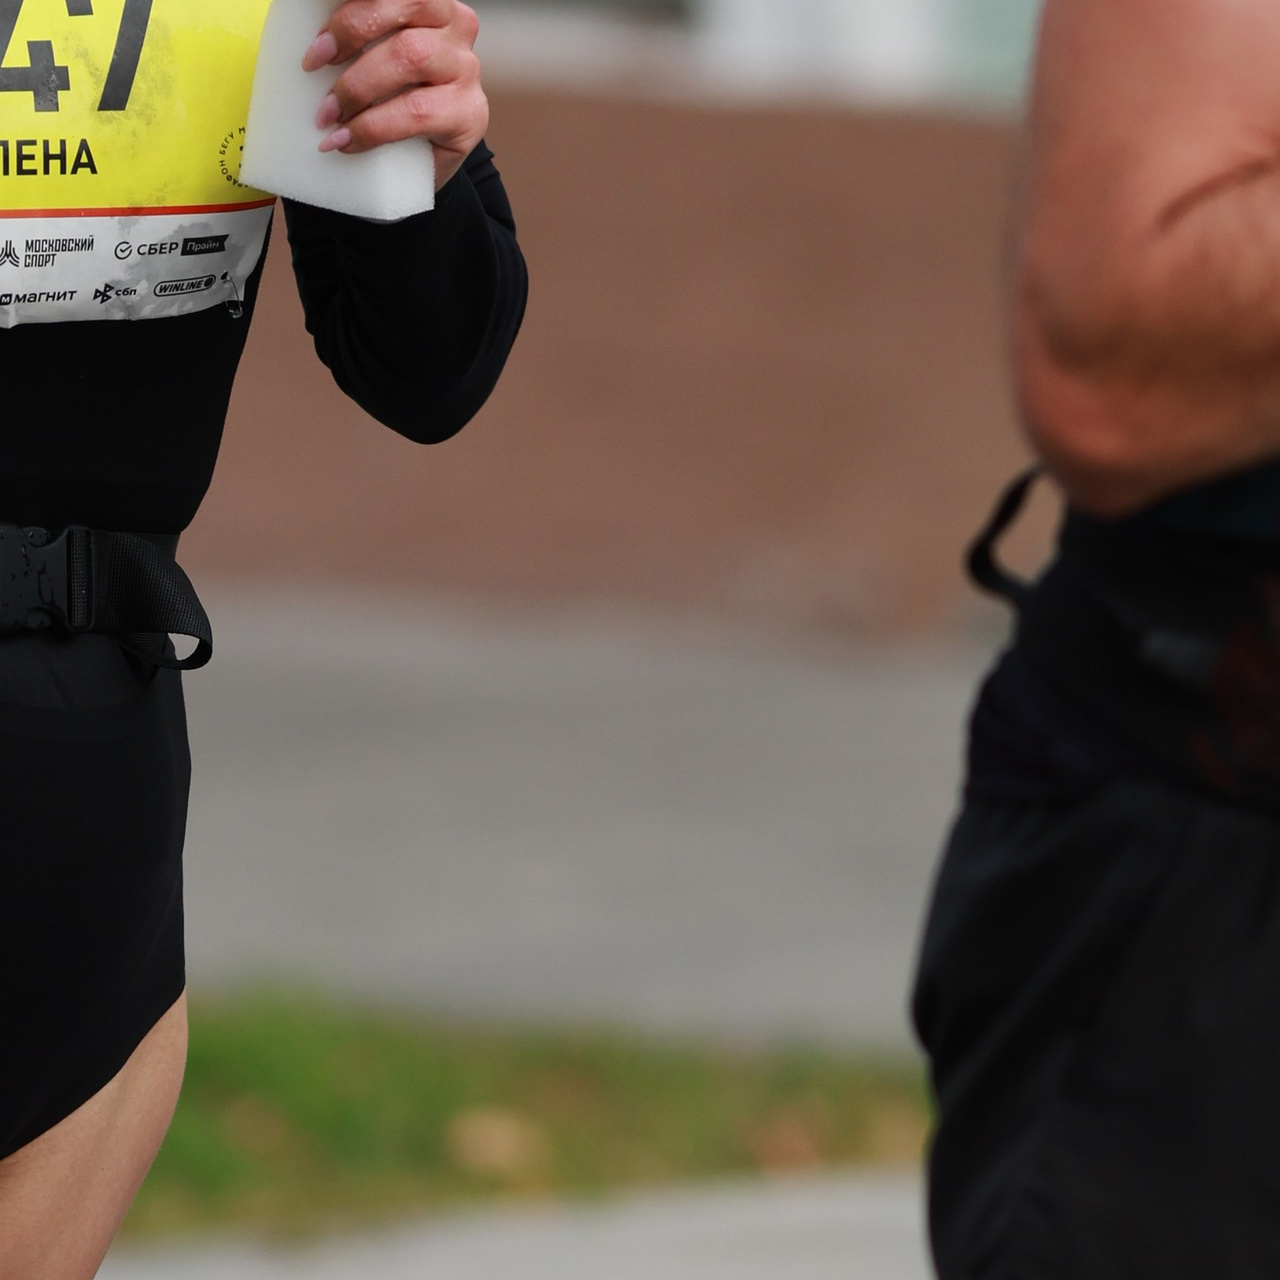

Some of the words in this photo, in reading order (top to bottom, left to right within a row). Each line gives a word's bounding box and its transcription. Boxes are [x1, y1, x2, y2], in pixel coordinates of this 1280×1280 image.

[25, 235, 94, 253] МОСКОВСКИЙ
[137, 242, 179, 256] СБЕР
[186, 240, 220, 252] Прайм
[24, 253, 57, 267] СПОРТ
[158, 280, 203, 293] WINLINE
